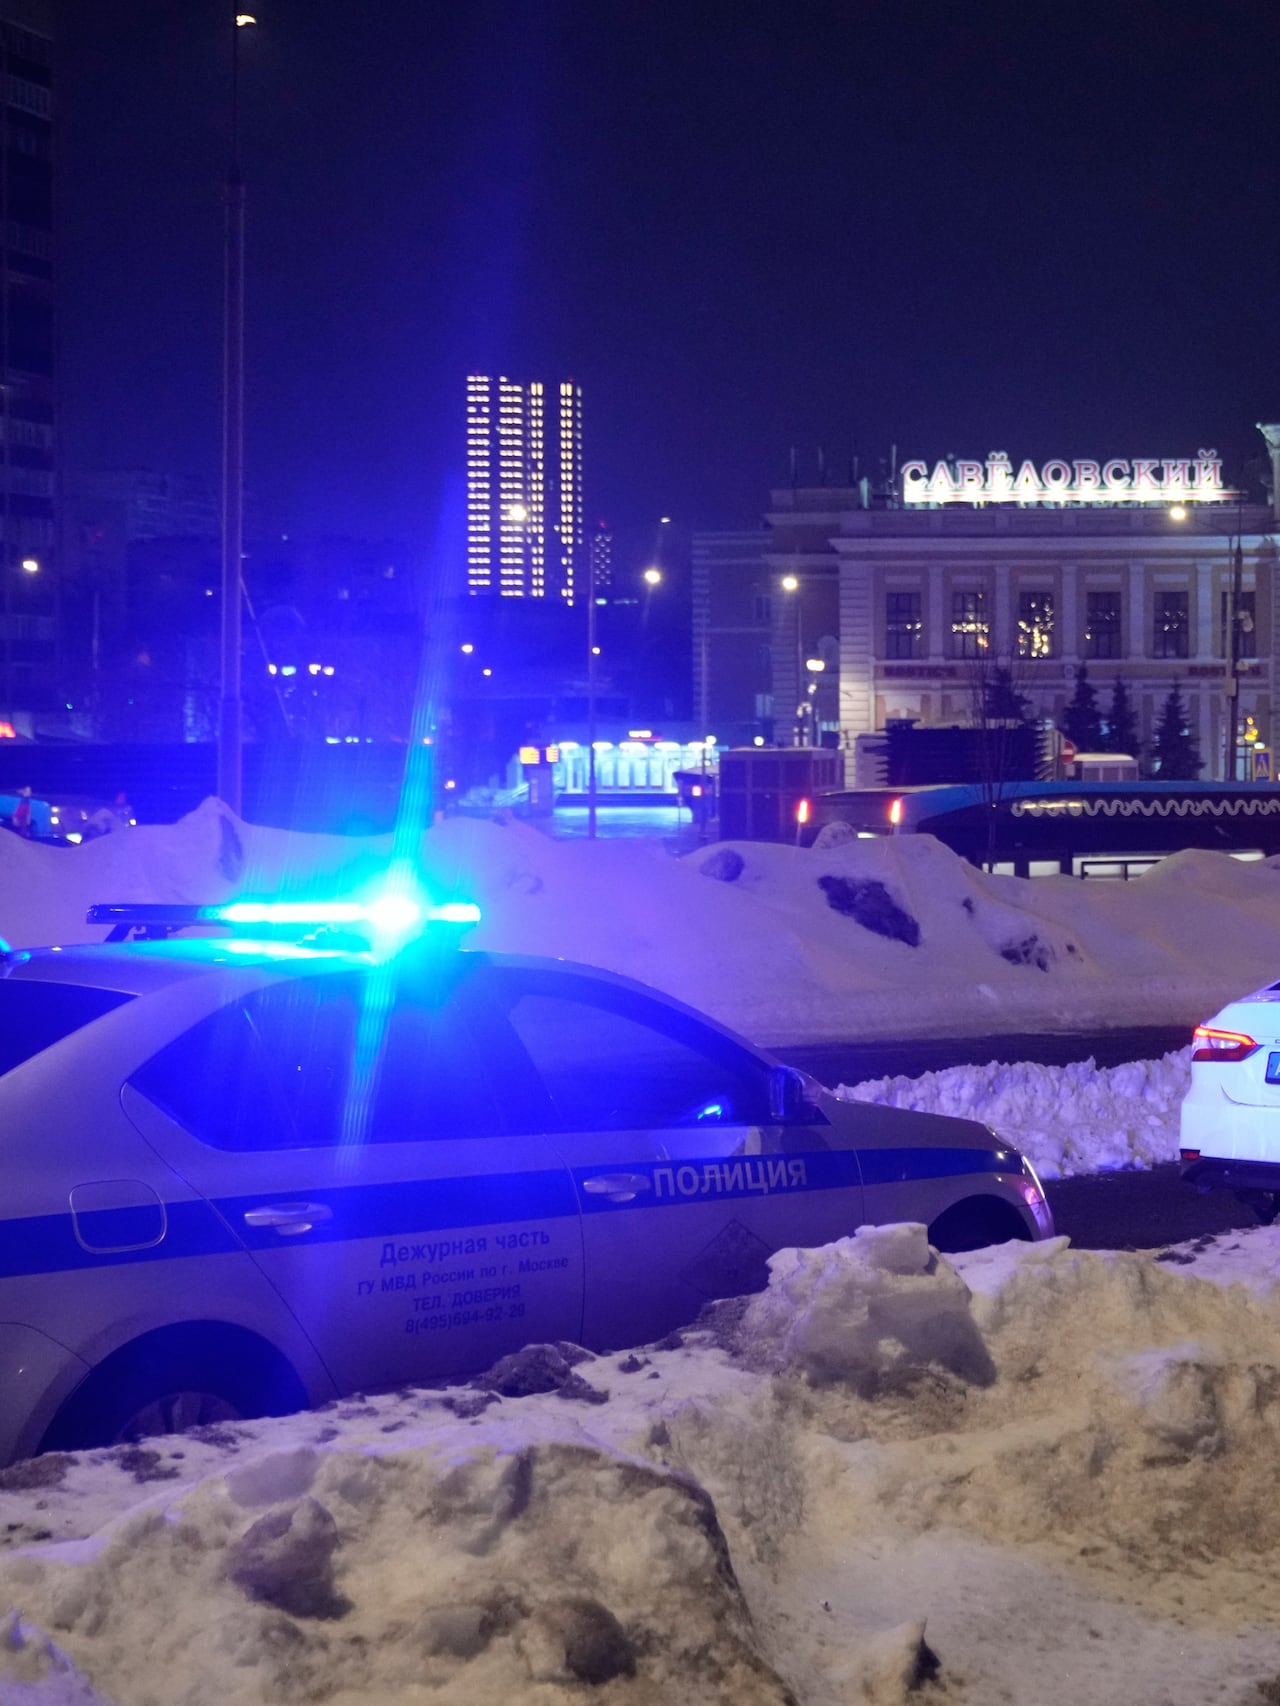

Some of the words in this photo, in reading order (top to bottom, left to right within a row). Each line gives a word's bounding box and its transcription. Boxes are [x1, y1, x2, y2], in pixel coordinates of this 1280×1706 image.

[901, 450, 1223, 491] САВЁЛОВСКИЙ
[653, 1159, 808, 1198] ПОЛИЦИЯ
[380, 1237, 488, 1268] Дежурная
[495, 1230, 551, 1250] часть
[357, 1280, 375, 1296] ГУ
[381, 1274, 417, 1293] МВД
[422, 1268, 475, 1287] России
[480, 1265, 497, 1279] по
[502, 1265, 513, 1276] г.
[518, 1256, 569, 1274] Москве
[413, 1296, 446, 1312] ТЕЛ.
[451, 1284, 521, 1308] ДОВЕРИЯ
[405, 1303, 526, 1335] 8(495)694-92-29
